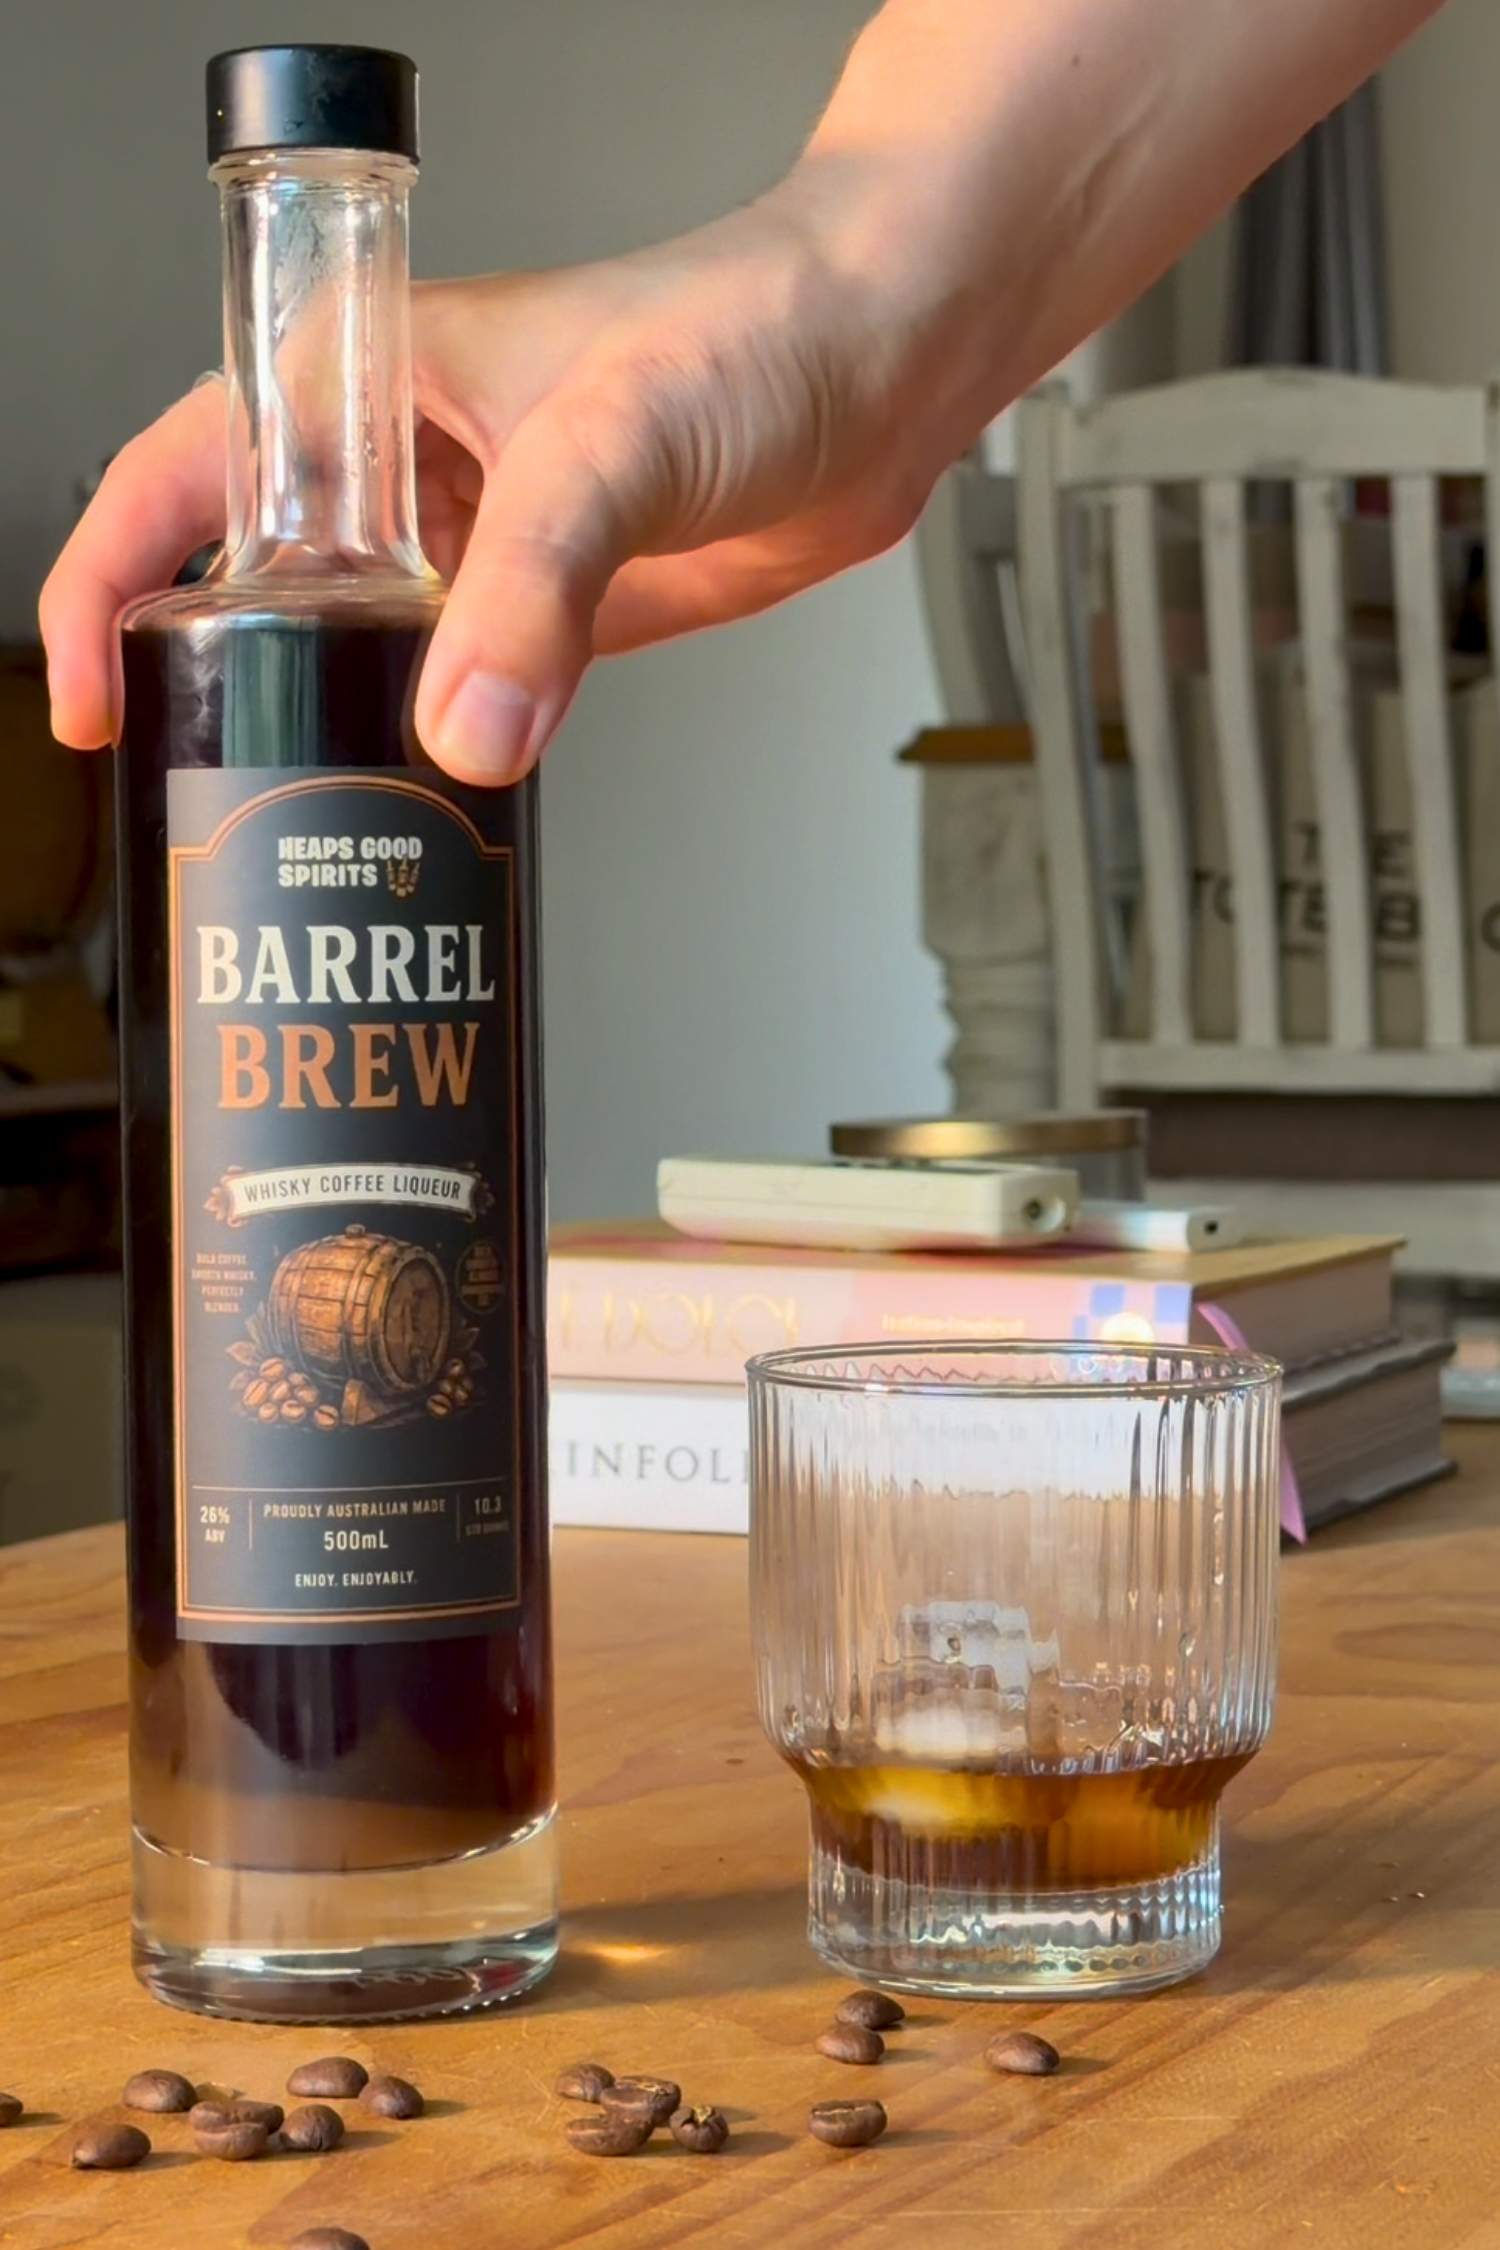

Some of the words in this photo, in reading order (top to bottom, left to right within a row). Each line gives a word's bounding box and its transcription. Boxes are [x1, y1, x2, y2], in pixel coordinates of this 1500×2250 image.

[278, 836, 354, 861] HEAPS
[360, 837, 423, 860] GOOD
[278, 864, 378, 887] SPIRITS
[196, 925, 496, 1004] BARREL
[217, 1022, 481, 1109] BREW
[244, 1176, 312, 1203] WHISKY
[319, 1174, 385, 1193] COFFEE
[392, 1174, 461, 1200] LIQUEUR
[200, 1506, 231, 1524] 26%
[263, 1502, 322, 1519] PROUDLY
[326, 1500, 410, 1519] AUSTRALIAN
[411, 1498, 447, 1514] MADE
[323, 1529, 390, 1551] 500mL
